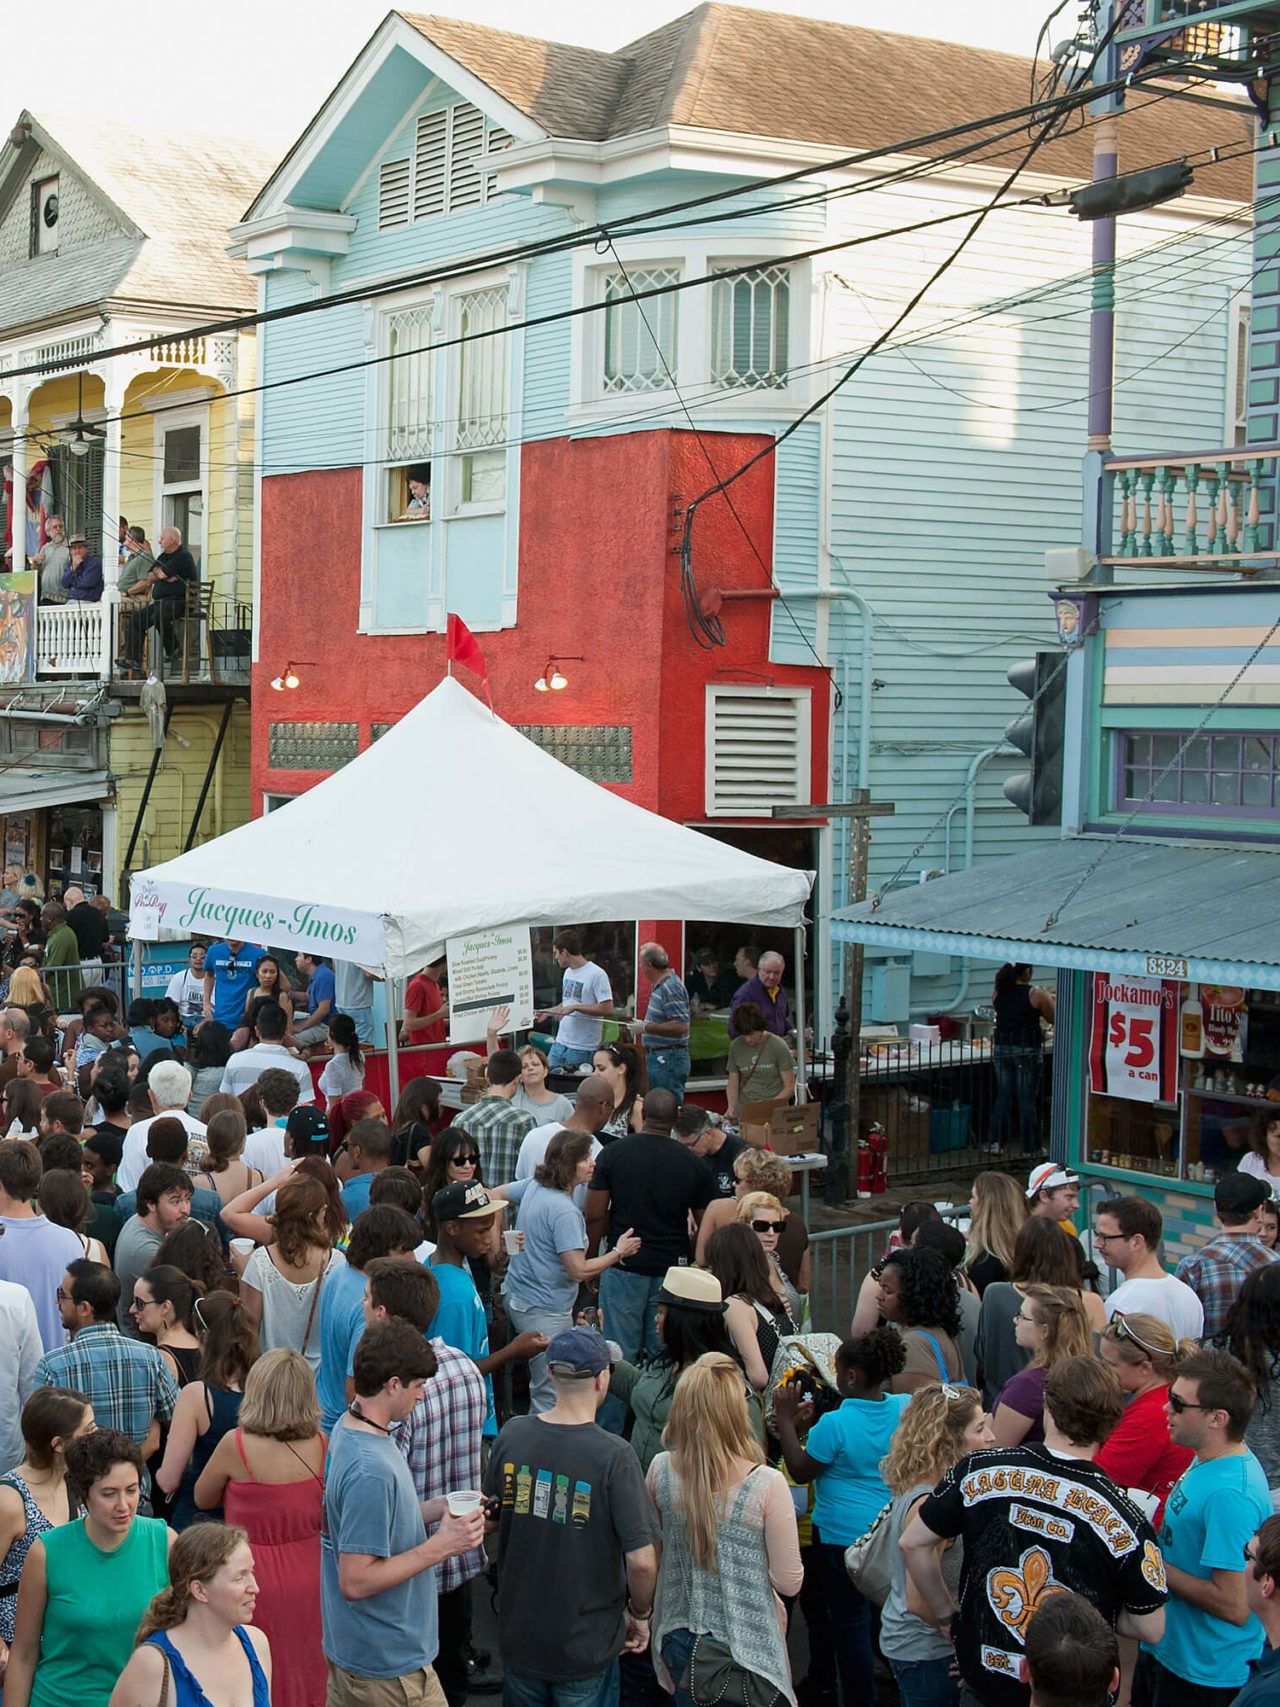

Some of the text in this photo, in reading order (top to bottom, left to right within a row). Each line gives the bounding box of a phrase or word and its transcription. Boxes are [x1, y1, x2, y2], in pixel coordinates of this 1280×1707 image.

[1148, 957, 1186, 977] 8324
[1097, 979, 1174, 1009] Jockamo's
[1210, 1003, 1241, 1025] Tito's
[1109, 1011, 1155, 1068] $5
[1128, 1070, 1158, 1082] a can
[964, 1469, 1134, 1552] LAGUNA BEACH
[986, 1653, 1015, 1672] est.
